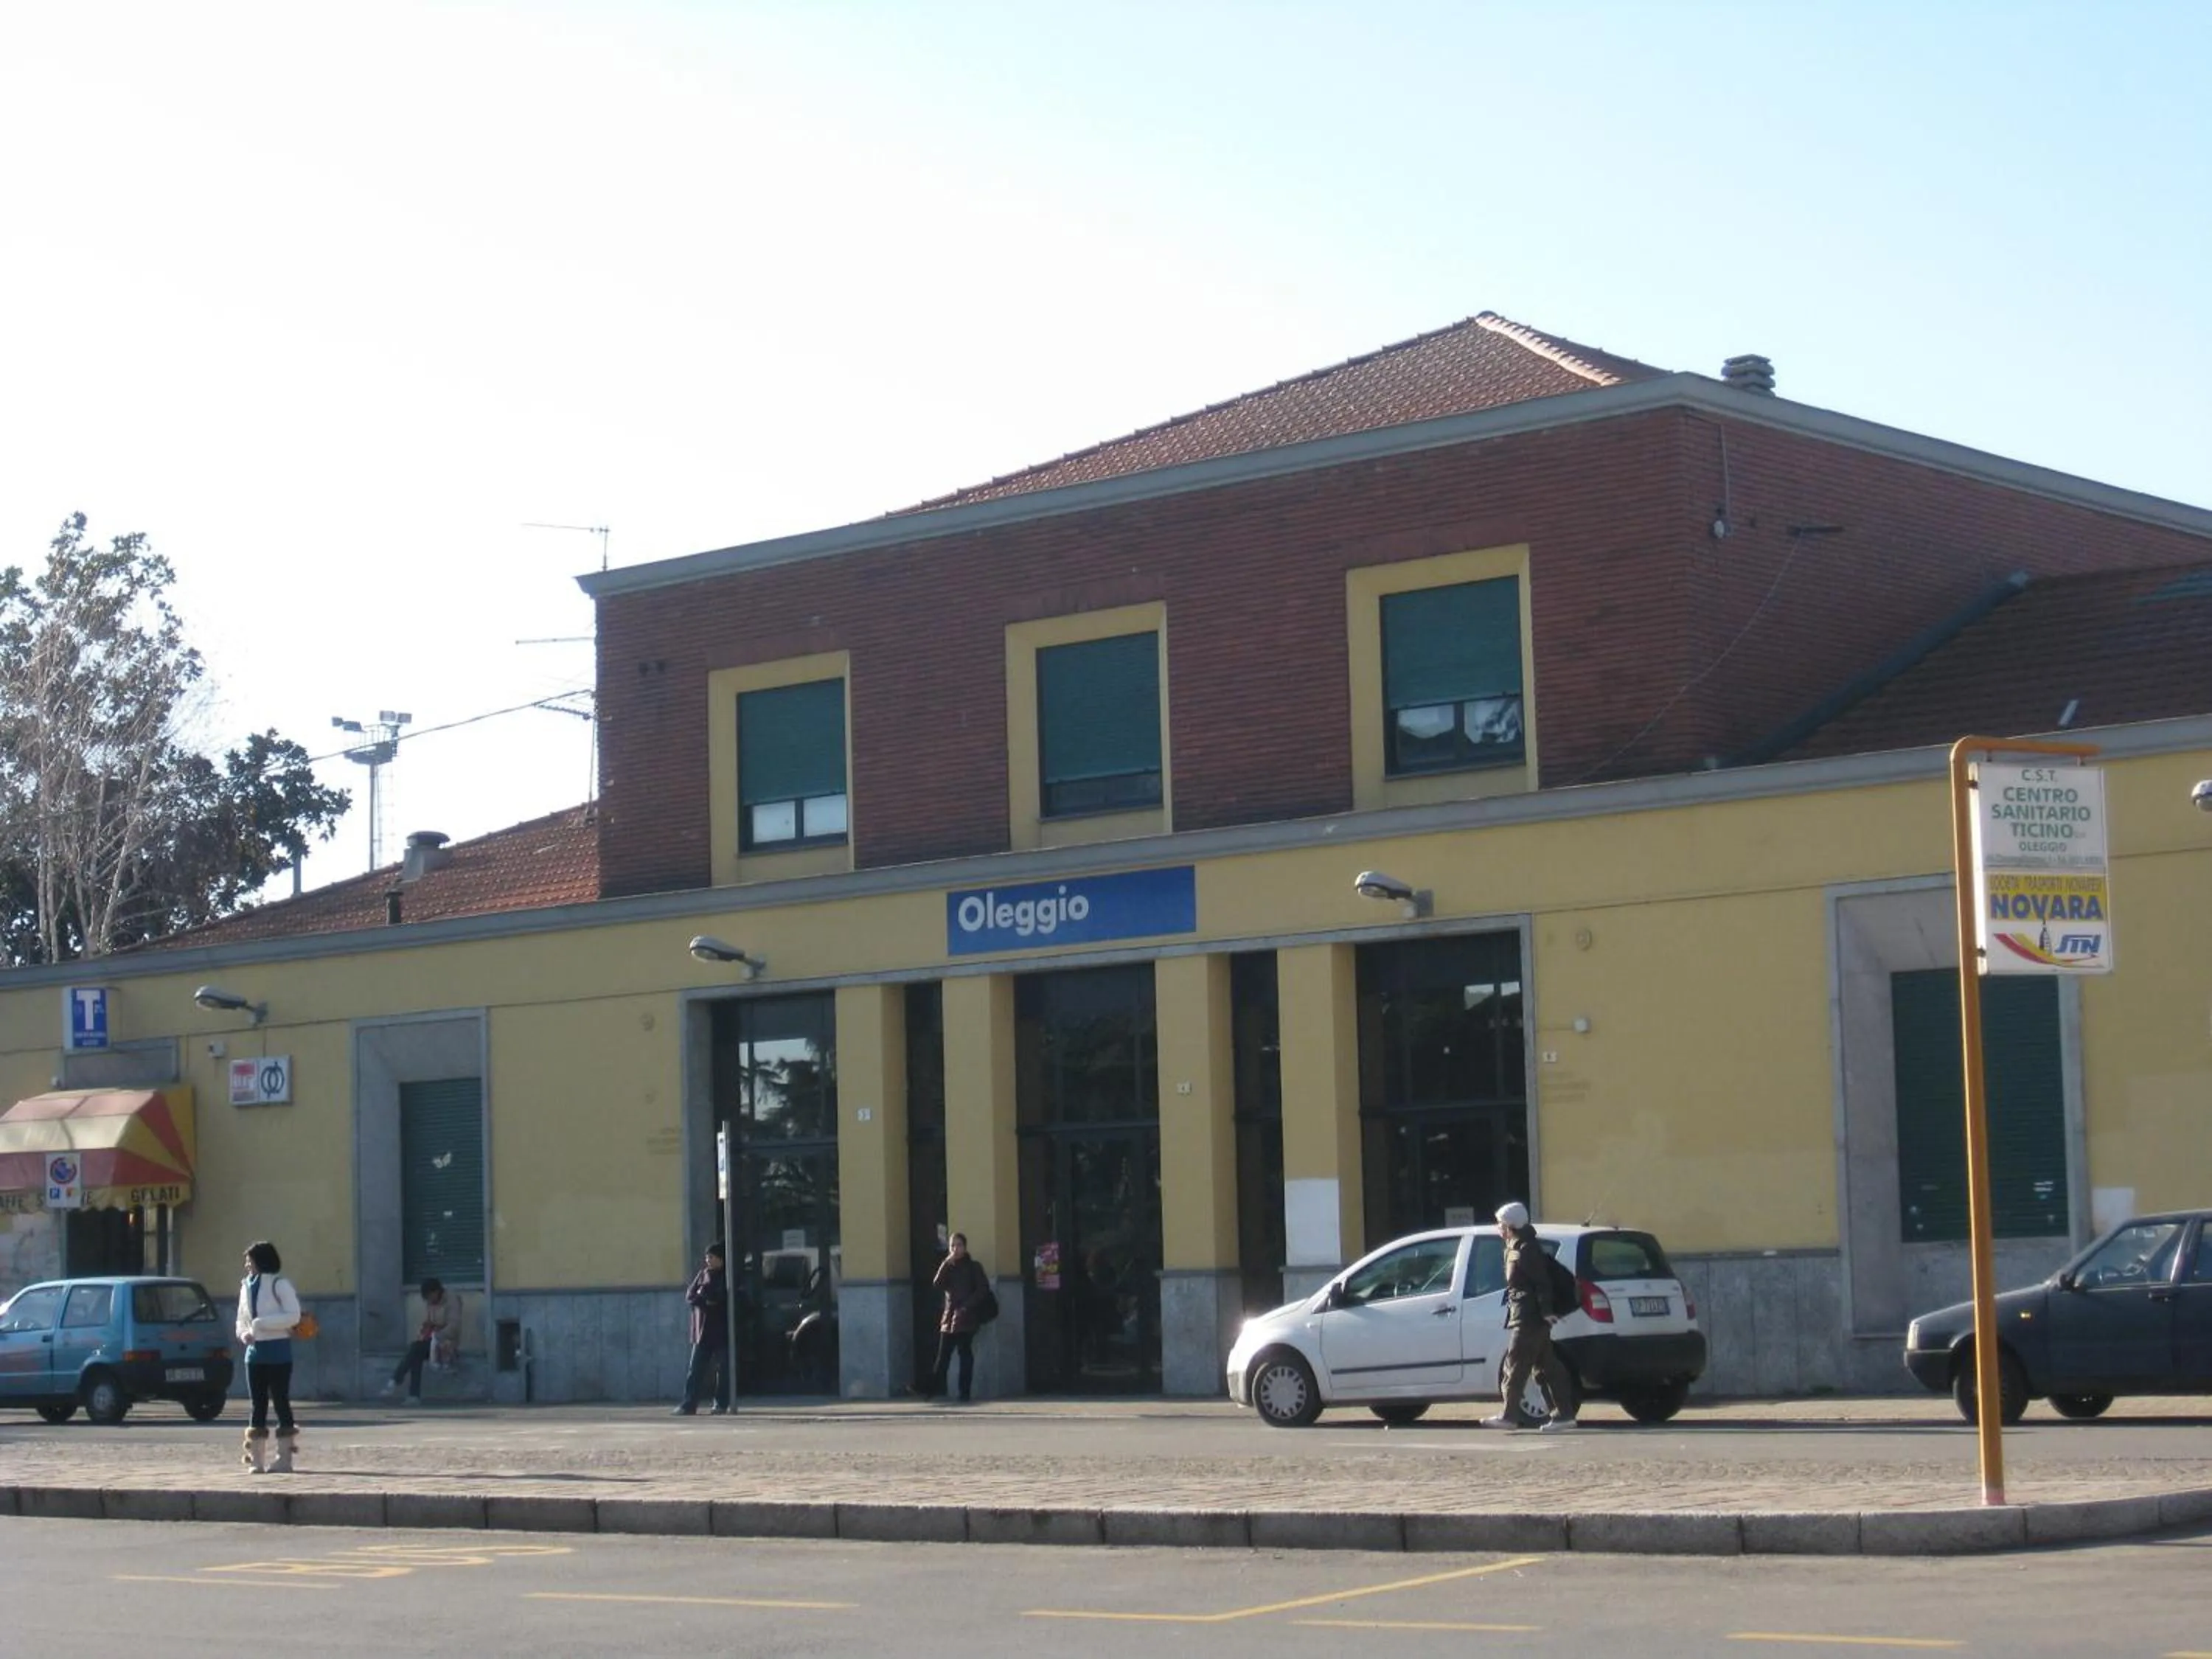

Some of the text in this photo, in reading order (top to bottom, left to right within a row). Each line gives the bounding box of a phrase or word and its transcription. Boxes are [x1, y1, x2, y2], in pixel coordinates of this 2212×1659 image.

[2003, 787, 2079, 803] CENTRO
[1991, 804, 2091, 821] SANITARIO
[2010, 822, 2073, 838] TICINO
[2018, 841, 2067, 852] OLEGGIO
[958, 885, 1089, 936] Oleggio
[1990, 893, 2104, 919] NOVARA
[76, 990, 100, 1030] T
